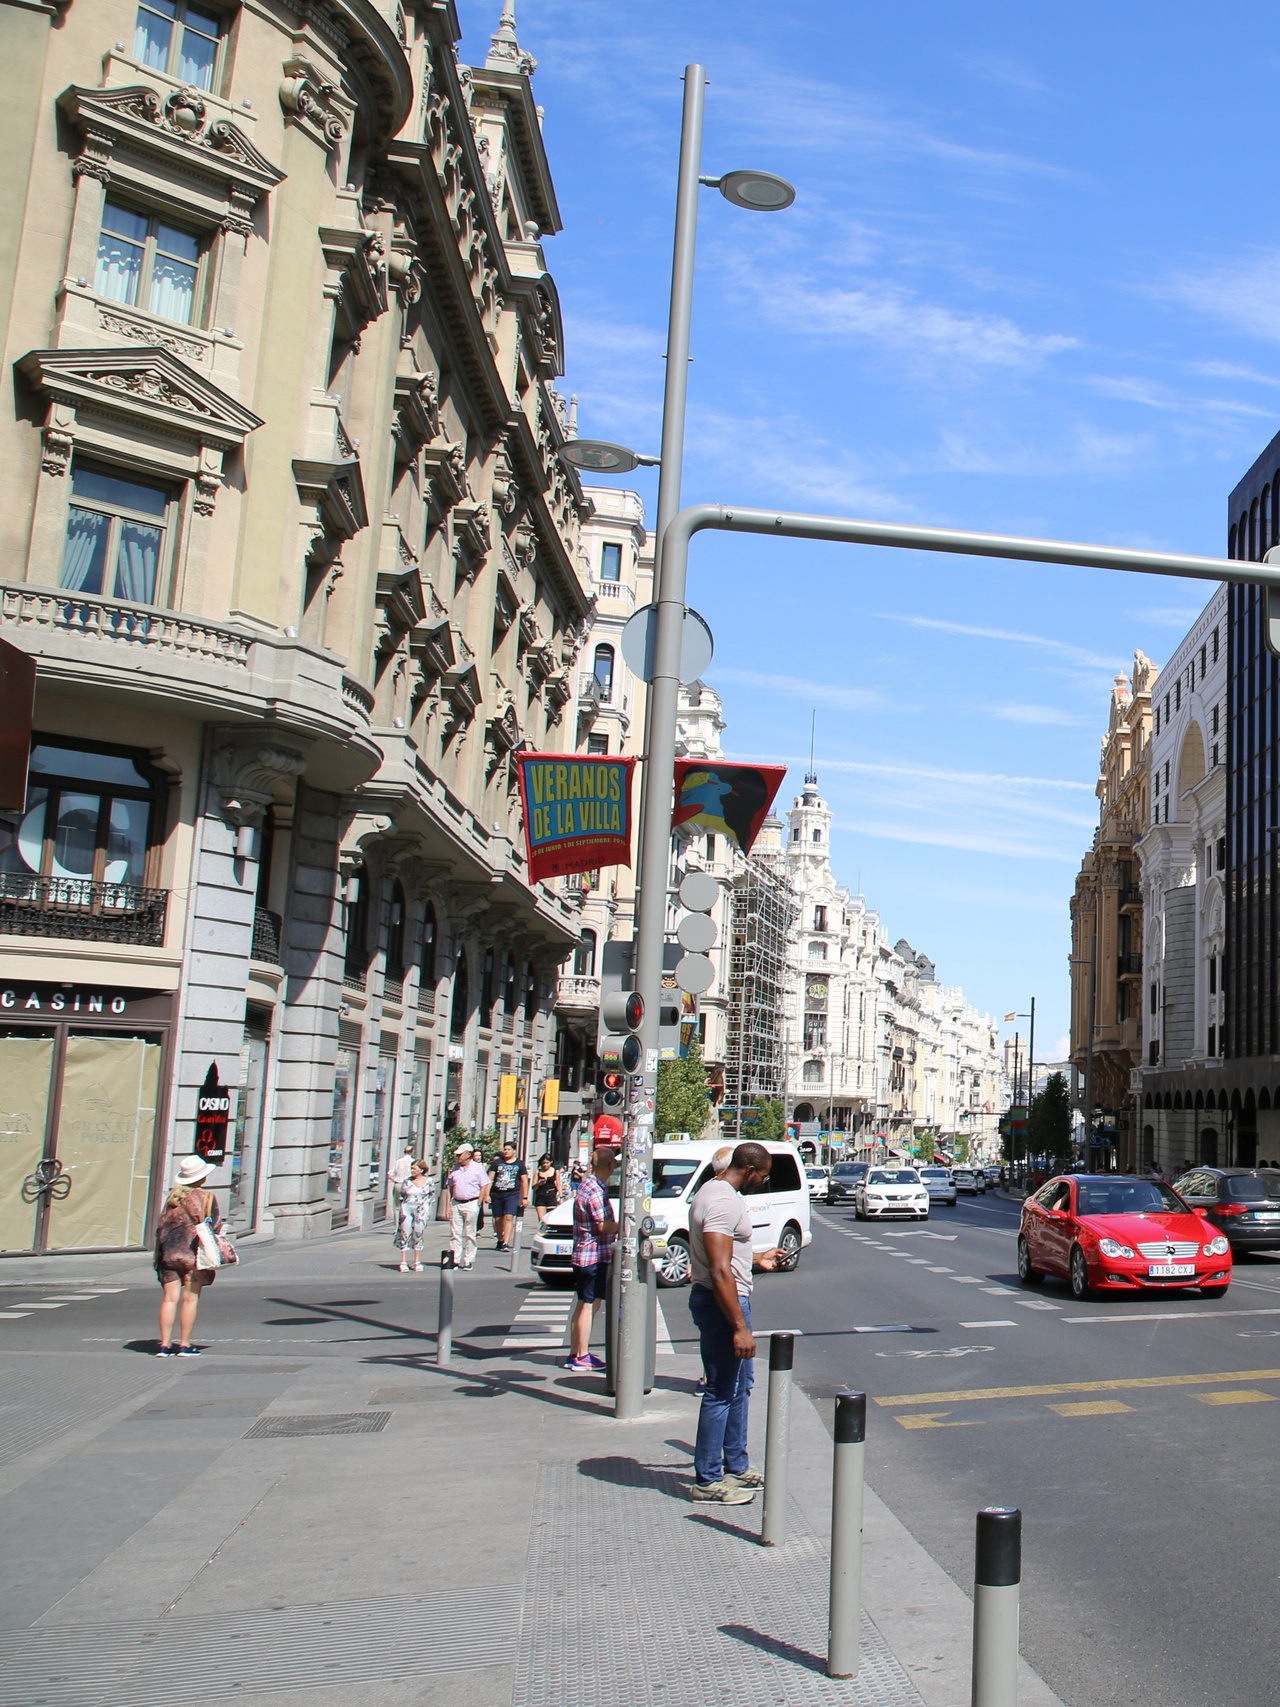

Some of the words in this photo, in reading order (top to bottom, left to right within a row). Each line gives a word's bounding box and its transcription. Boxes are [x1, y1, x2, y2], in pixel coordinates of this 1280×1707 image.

[531, 764, 621, 804] VERANOS
[533, 805, 552, 840] DE
[557, 803, 575, 834] LA
[578, 801, 621, 831] VILLA
[576, 837, 610, 846] SEPTIEMBRE
[565, 856, 605, 870] MADRID
[1, 990, 126, 1014] CASINO
[200, 1098, 229, 1111] CASINO
[71, 1121, 110, 1132] GRAN
[80, 1132, 130, 1143] POKER
[1155, 1266, 1176, 1275] 1182
[1177, 1265, 1194, 1275] CXJ
